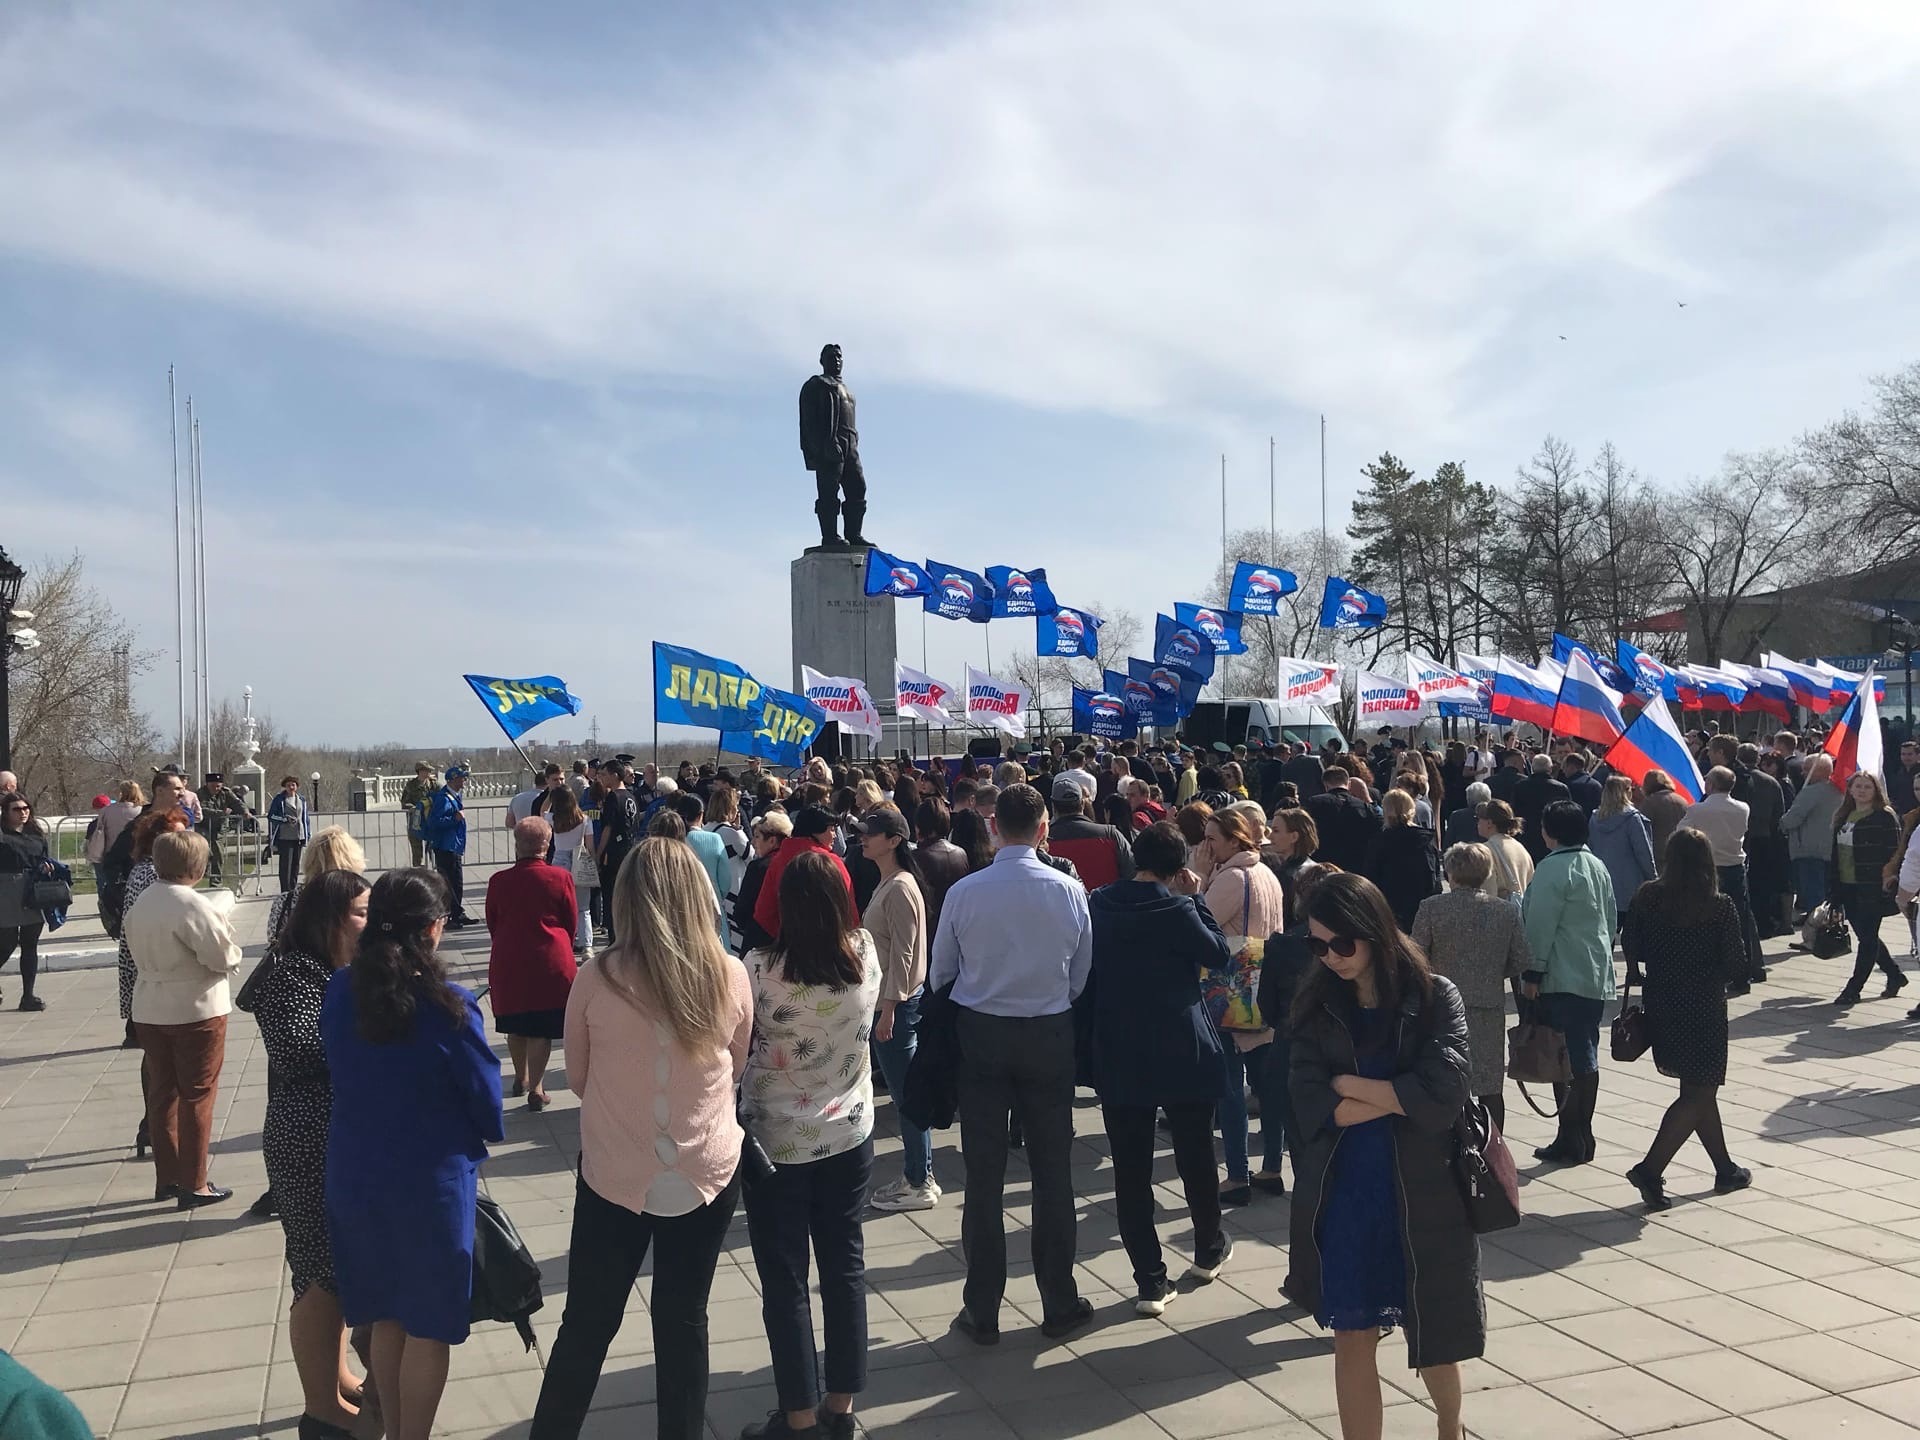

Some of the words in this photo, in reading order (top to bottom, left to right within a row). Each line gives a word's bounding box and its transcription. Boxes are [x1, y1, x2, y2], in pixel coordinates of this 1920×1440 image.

[939, 602, 971, 613] ЕДИНАЯ
[665, 664, 760, 710] ЛДПР
[1362, 689, 1420, 714] ГВАРДИЯ
[754, 703, 816, 745] ДПР
[1091, 728, 1121, 736] РОССИЯ
